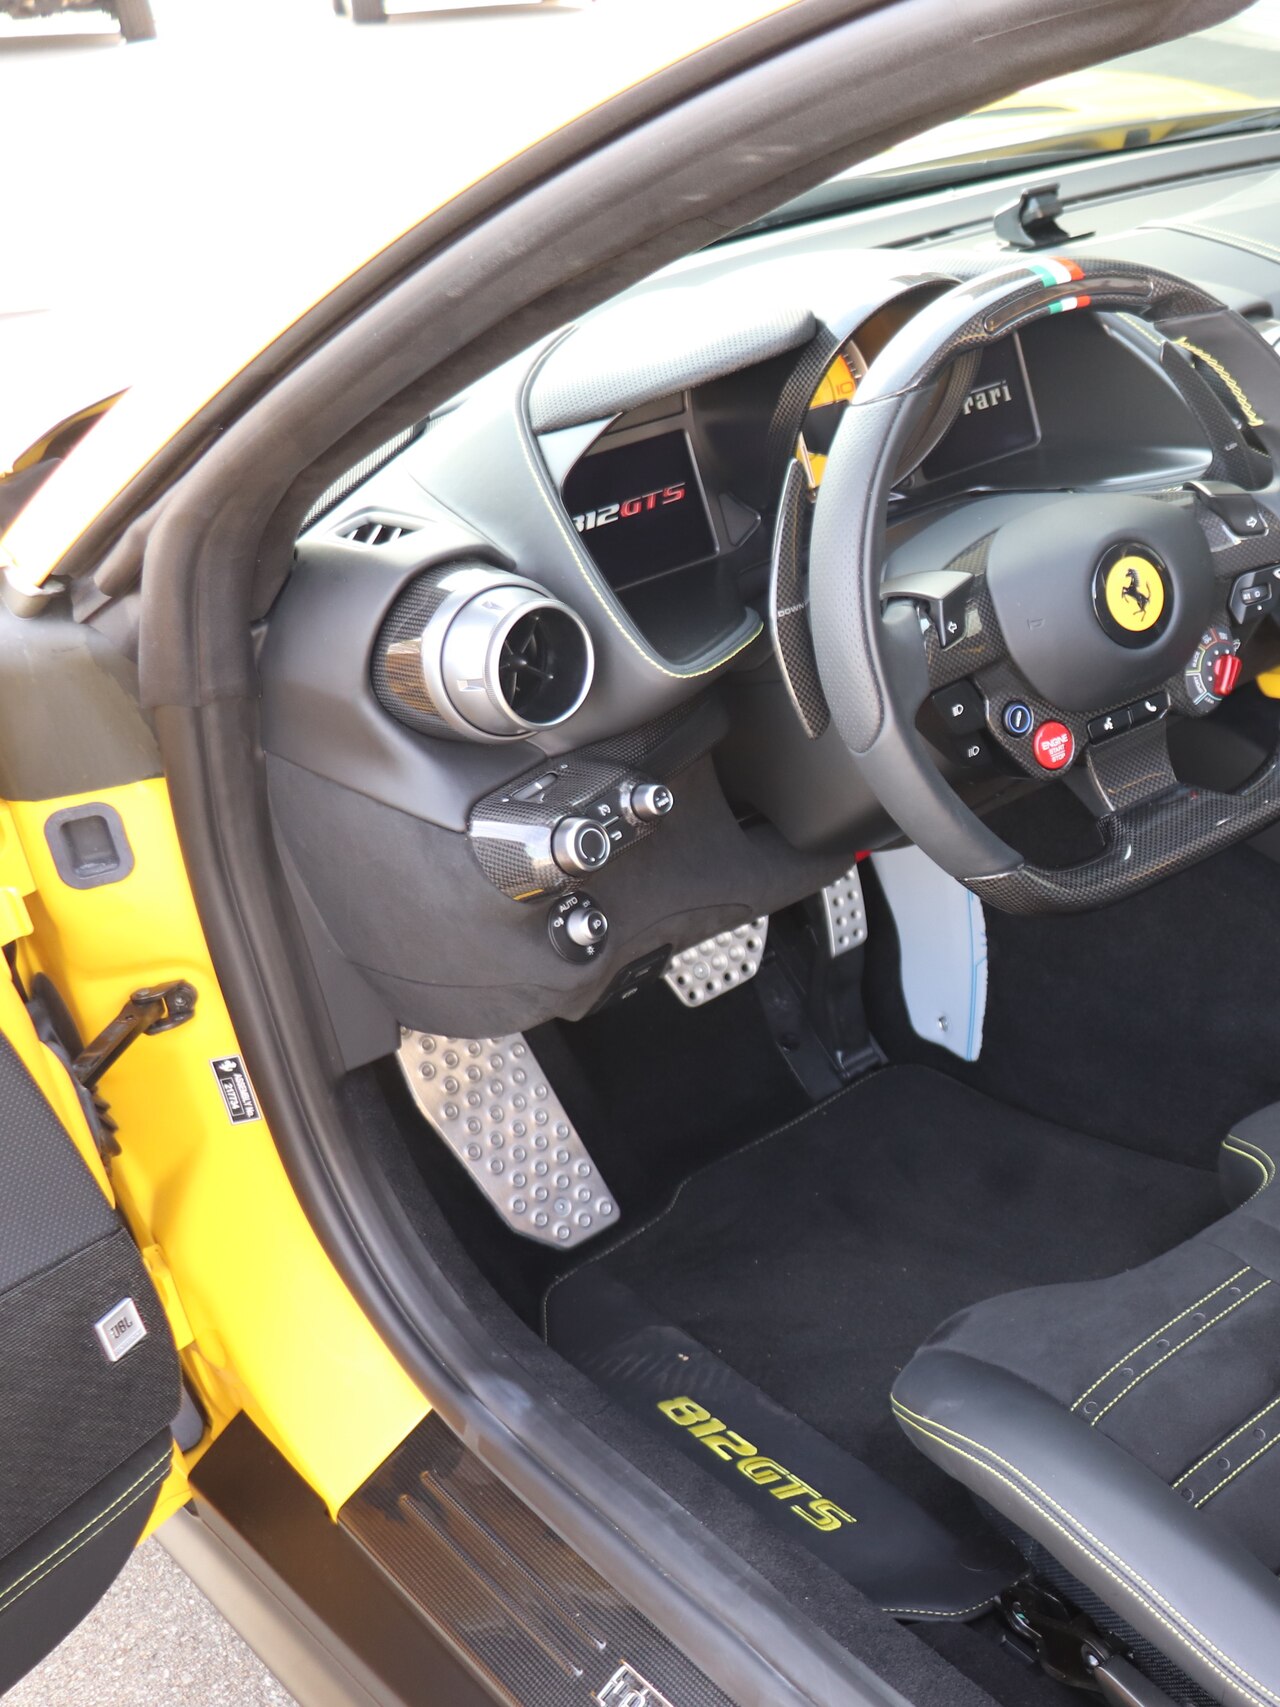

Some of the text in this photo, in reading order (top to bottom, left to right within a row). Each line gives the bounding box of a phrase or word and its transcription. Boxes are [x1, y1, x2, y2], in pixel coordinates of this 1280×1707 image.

[963, 380, 1012, 415] rari
[777, 602, 805, 618] DOWN
[1041, 733, 1068, 751] ENGINE
[559, 896, 578, 912] AUTO
[110, 1317, 134, 1339] JBL
[657, 1396, 857, 1531] 812GTS
